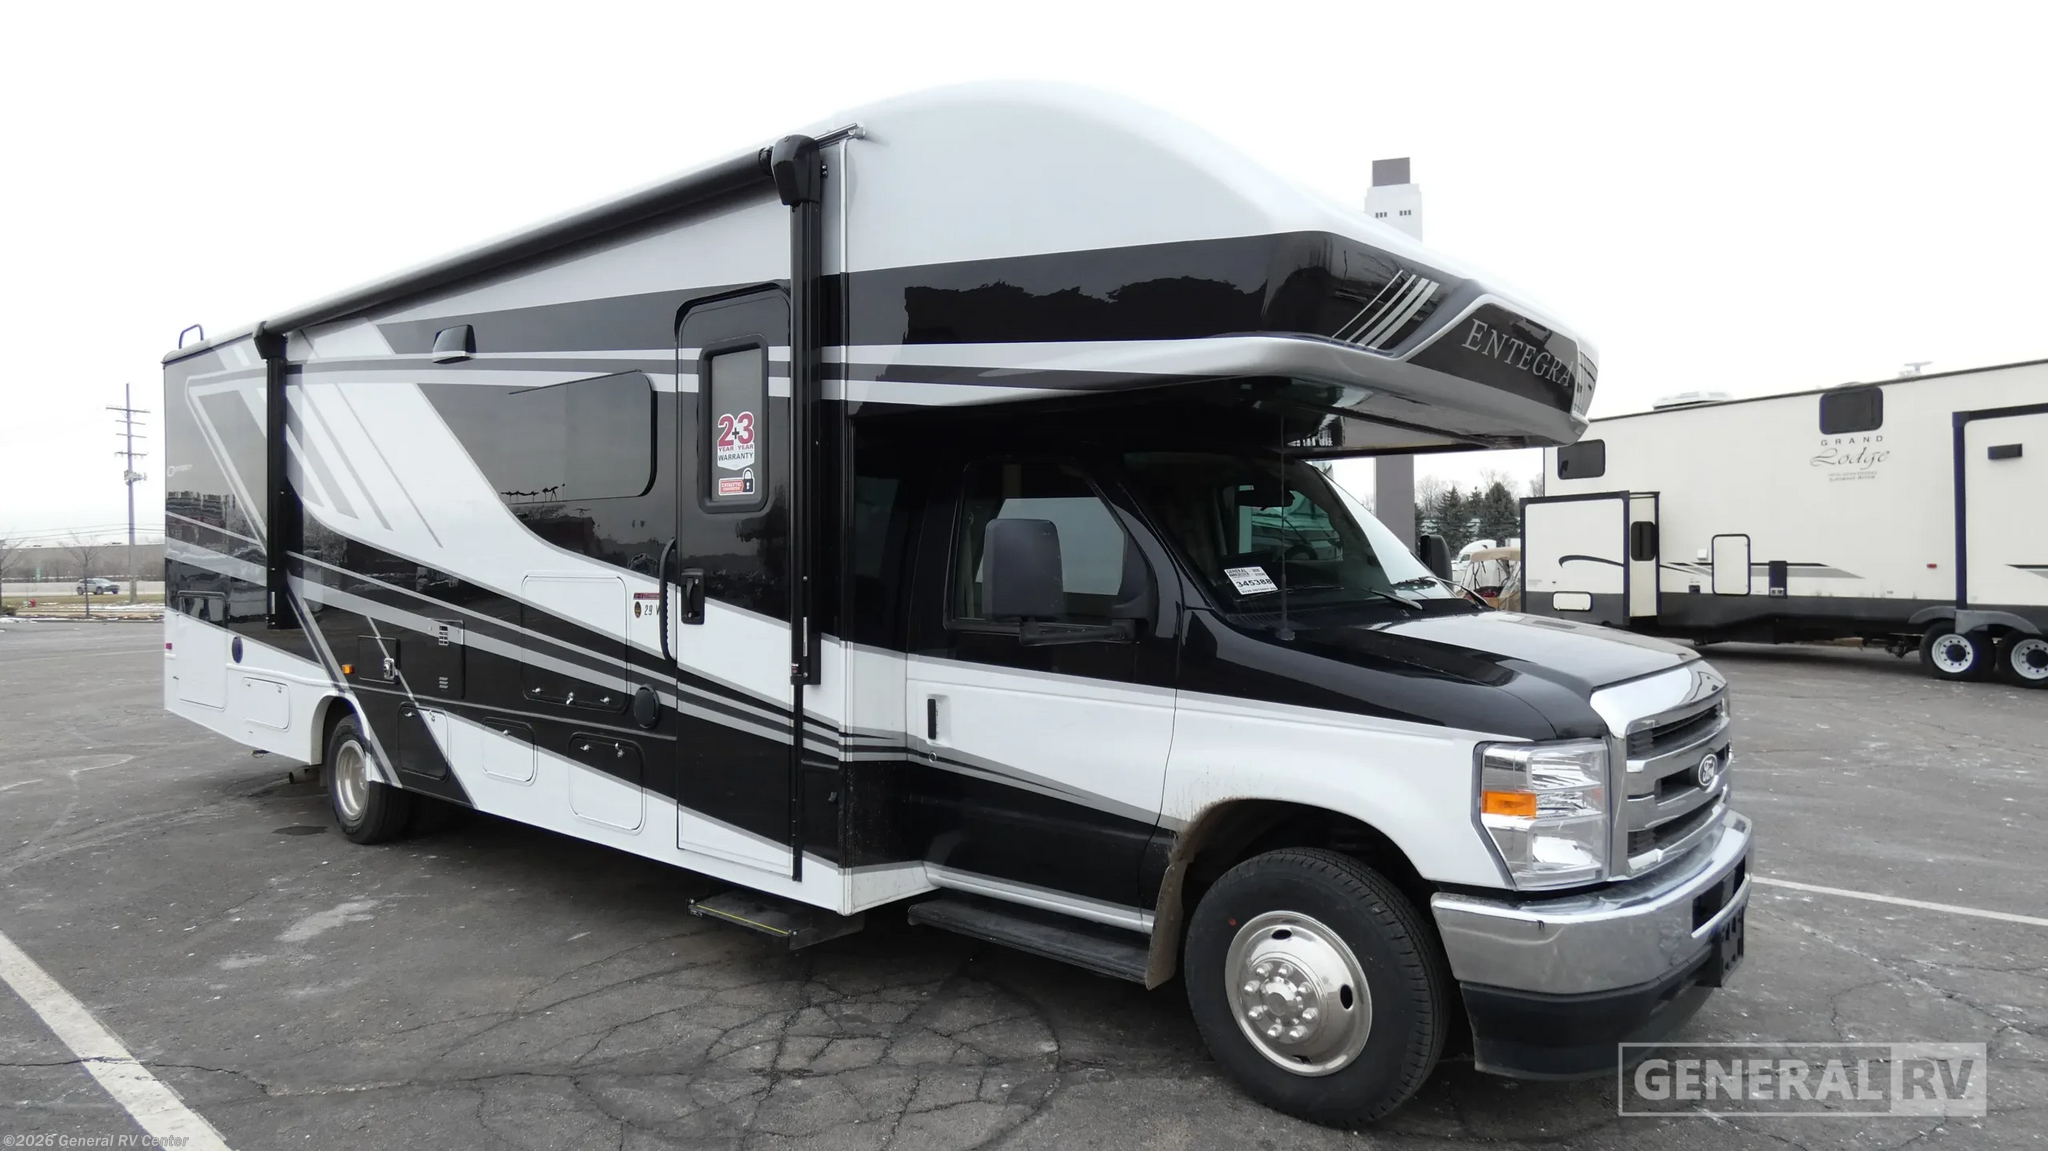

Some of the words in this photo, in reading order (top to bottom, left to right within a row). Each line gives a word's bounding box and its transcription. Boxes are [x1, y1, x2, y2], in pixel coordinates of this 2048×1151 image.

[1462, 318, 1574, 387] ENTEGRA
[1820, 435, 1883, 446] GRAND
[718, 452, 754, 461] WARRANTY
[1810, 446, 1890, 470] Lodge
[1235, 578, 1273, 588] 345388
[644, 604, 653, 616] 29
